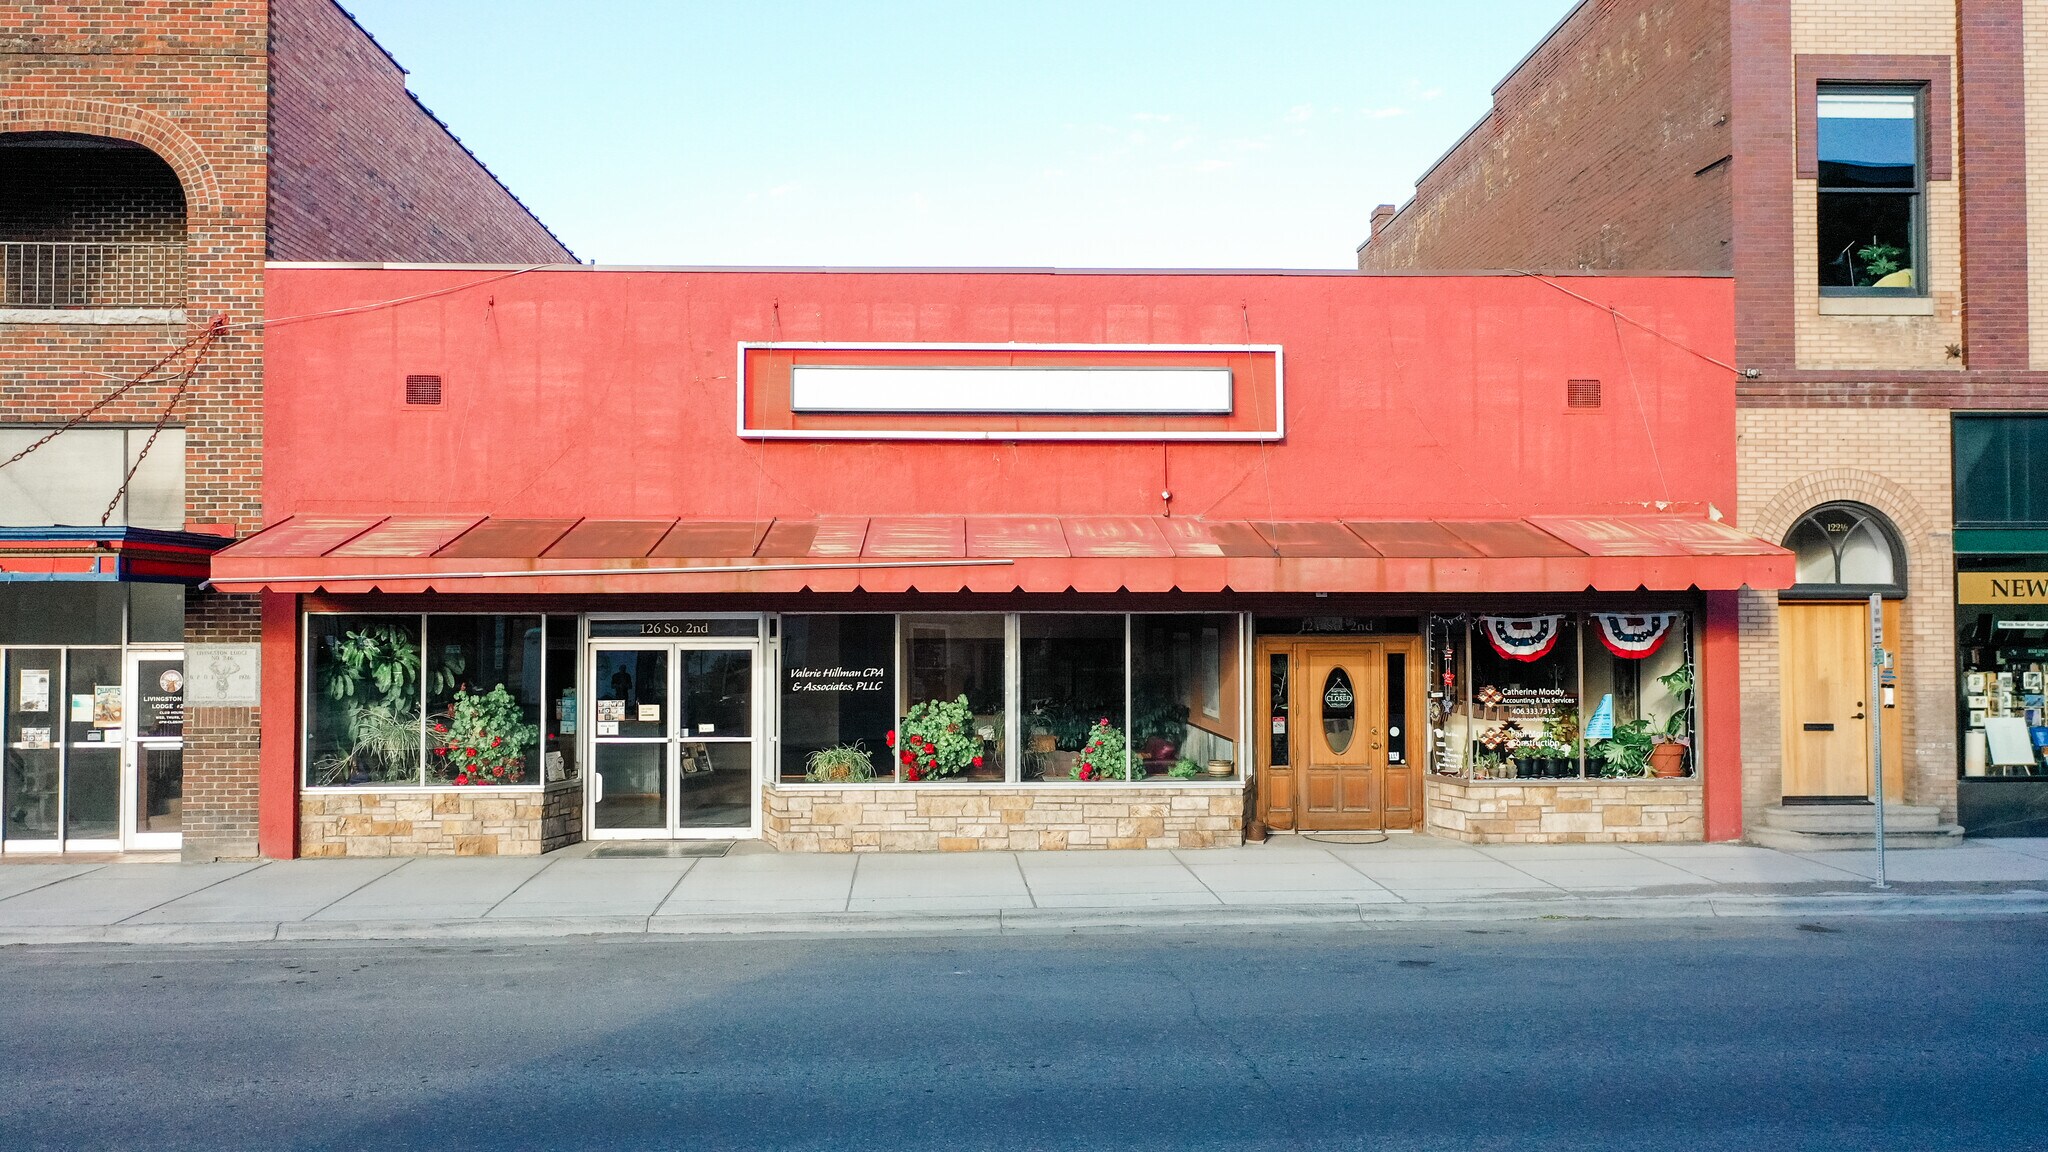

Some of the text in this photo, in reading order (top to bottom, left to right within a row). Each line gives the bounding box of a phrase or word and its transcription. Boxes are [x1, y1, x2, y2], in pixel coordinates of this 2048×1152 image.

[1991, 579, 2048, 597] NEW
[640, 622, 708, 634] 126 So. 2nd
[1350, 620, 1373, 630] 2nd
[790, 666, 884, 678] Valerie Hillman CPA
[792, 682, 884, 692] & Associates, PLLC
[1538, 688, 1564, 696] Moody
